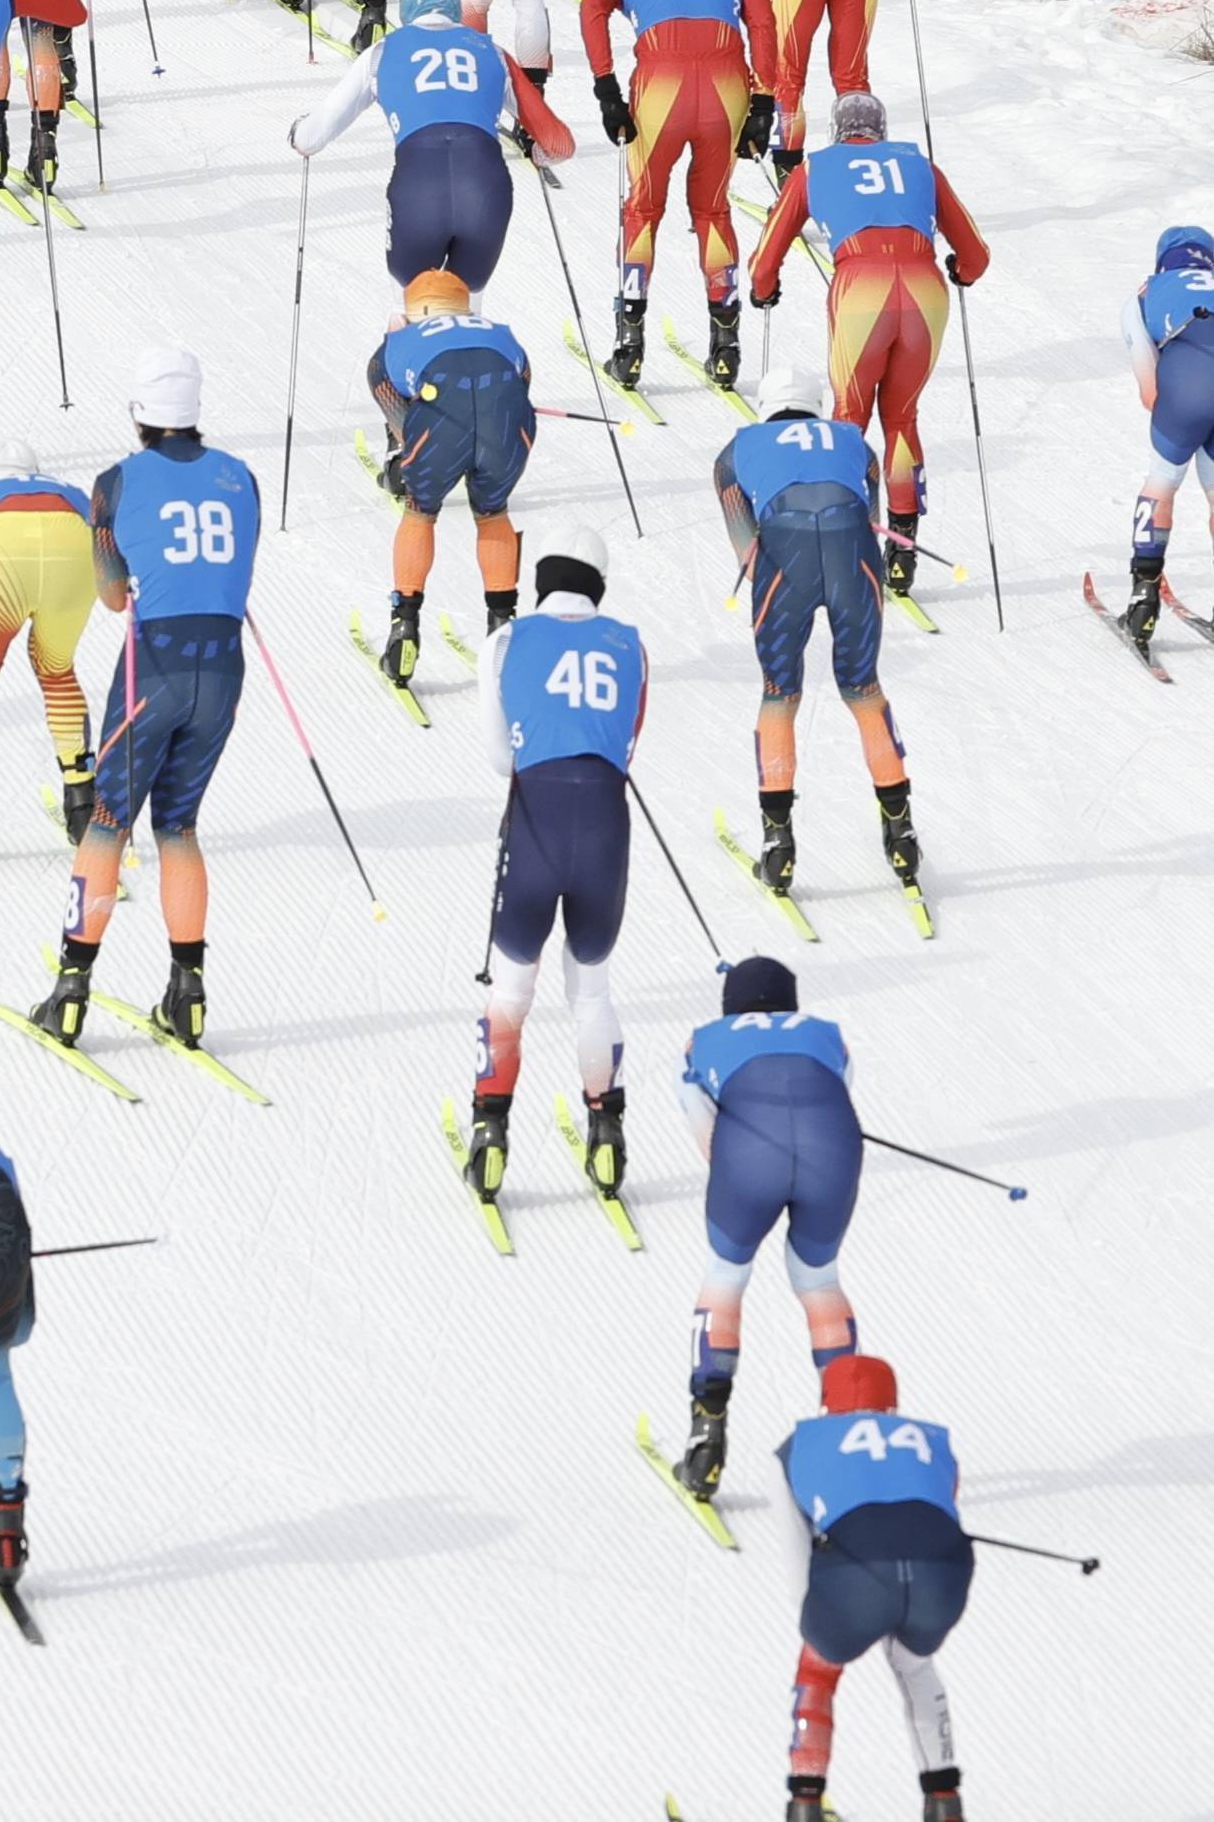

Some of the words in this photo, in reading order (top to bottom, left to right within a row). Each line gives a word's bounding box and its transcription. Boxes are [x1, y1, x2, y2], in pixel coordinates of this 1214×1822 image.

[411, 48, 477, 92] 28
[849, 159, 904, 194] 31
[624, 268, 641, 299] 4
[777, 422, 834, 450] 41
[160, 501, 234, 563] 38
[1135, 501, 1153, 542] 2
[546, 651, 617, 710] 46
[66, 881, 80, 929] 8
[840, 1420, 931, 1462] 44
